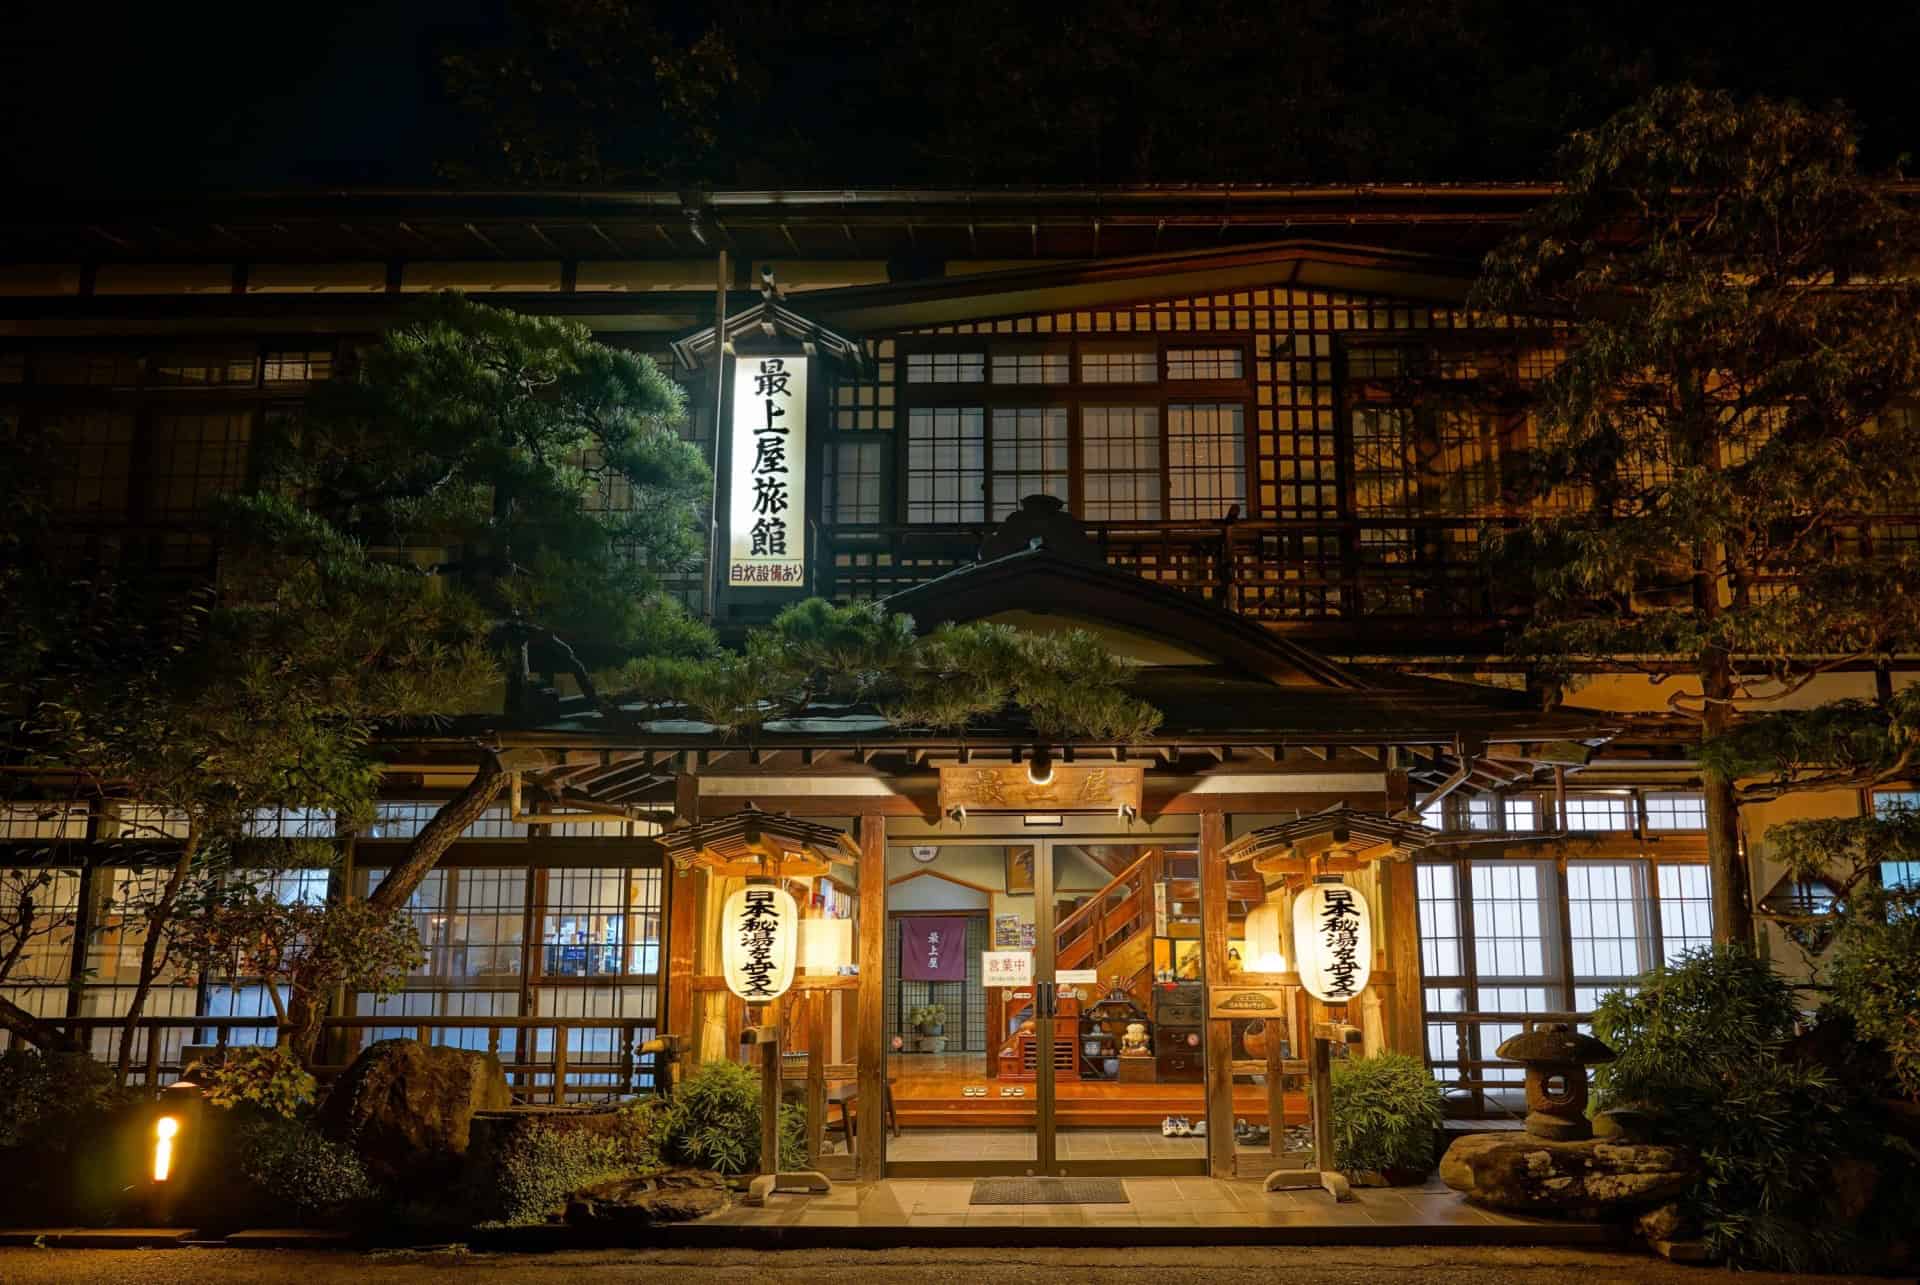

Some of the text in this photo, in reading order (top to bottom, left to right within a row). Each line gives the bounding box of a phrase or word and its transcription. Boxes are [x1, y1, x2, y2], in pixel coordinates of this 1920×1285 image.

[751, 359, 791, 556] 最上屋旅館
[731, 563, 803, 582] 自炊設備あり
[738, 890, 780, 997] 日本秘湯を守る会
[989, 958, 1025, 973] 営業中
[1319, 889, 1361, 997] 日本秘湯を守る会
